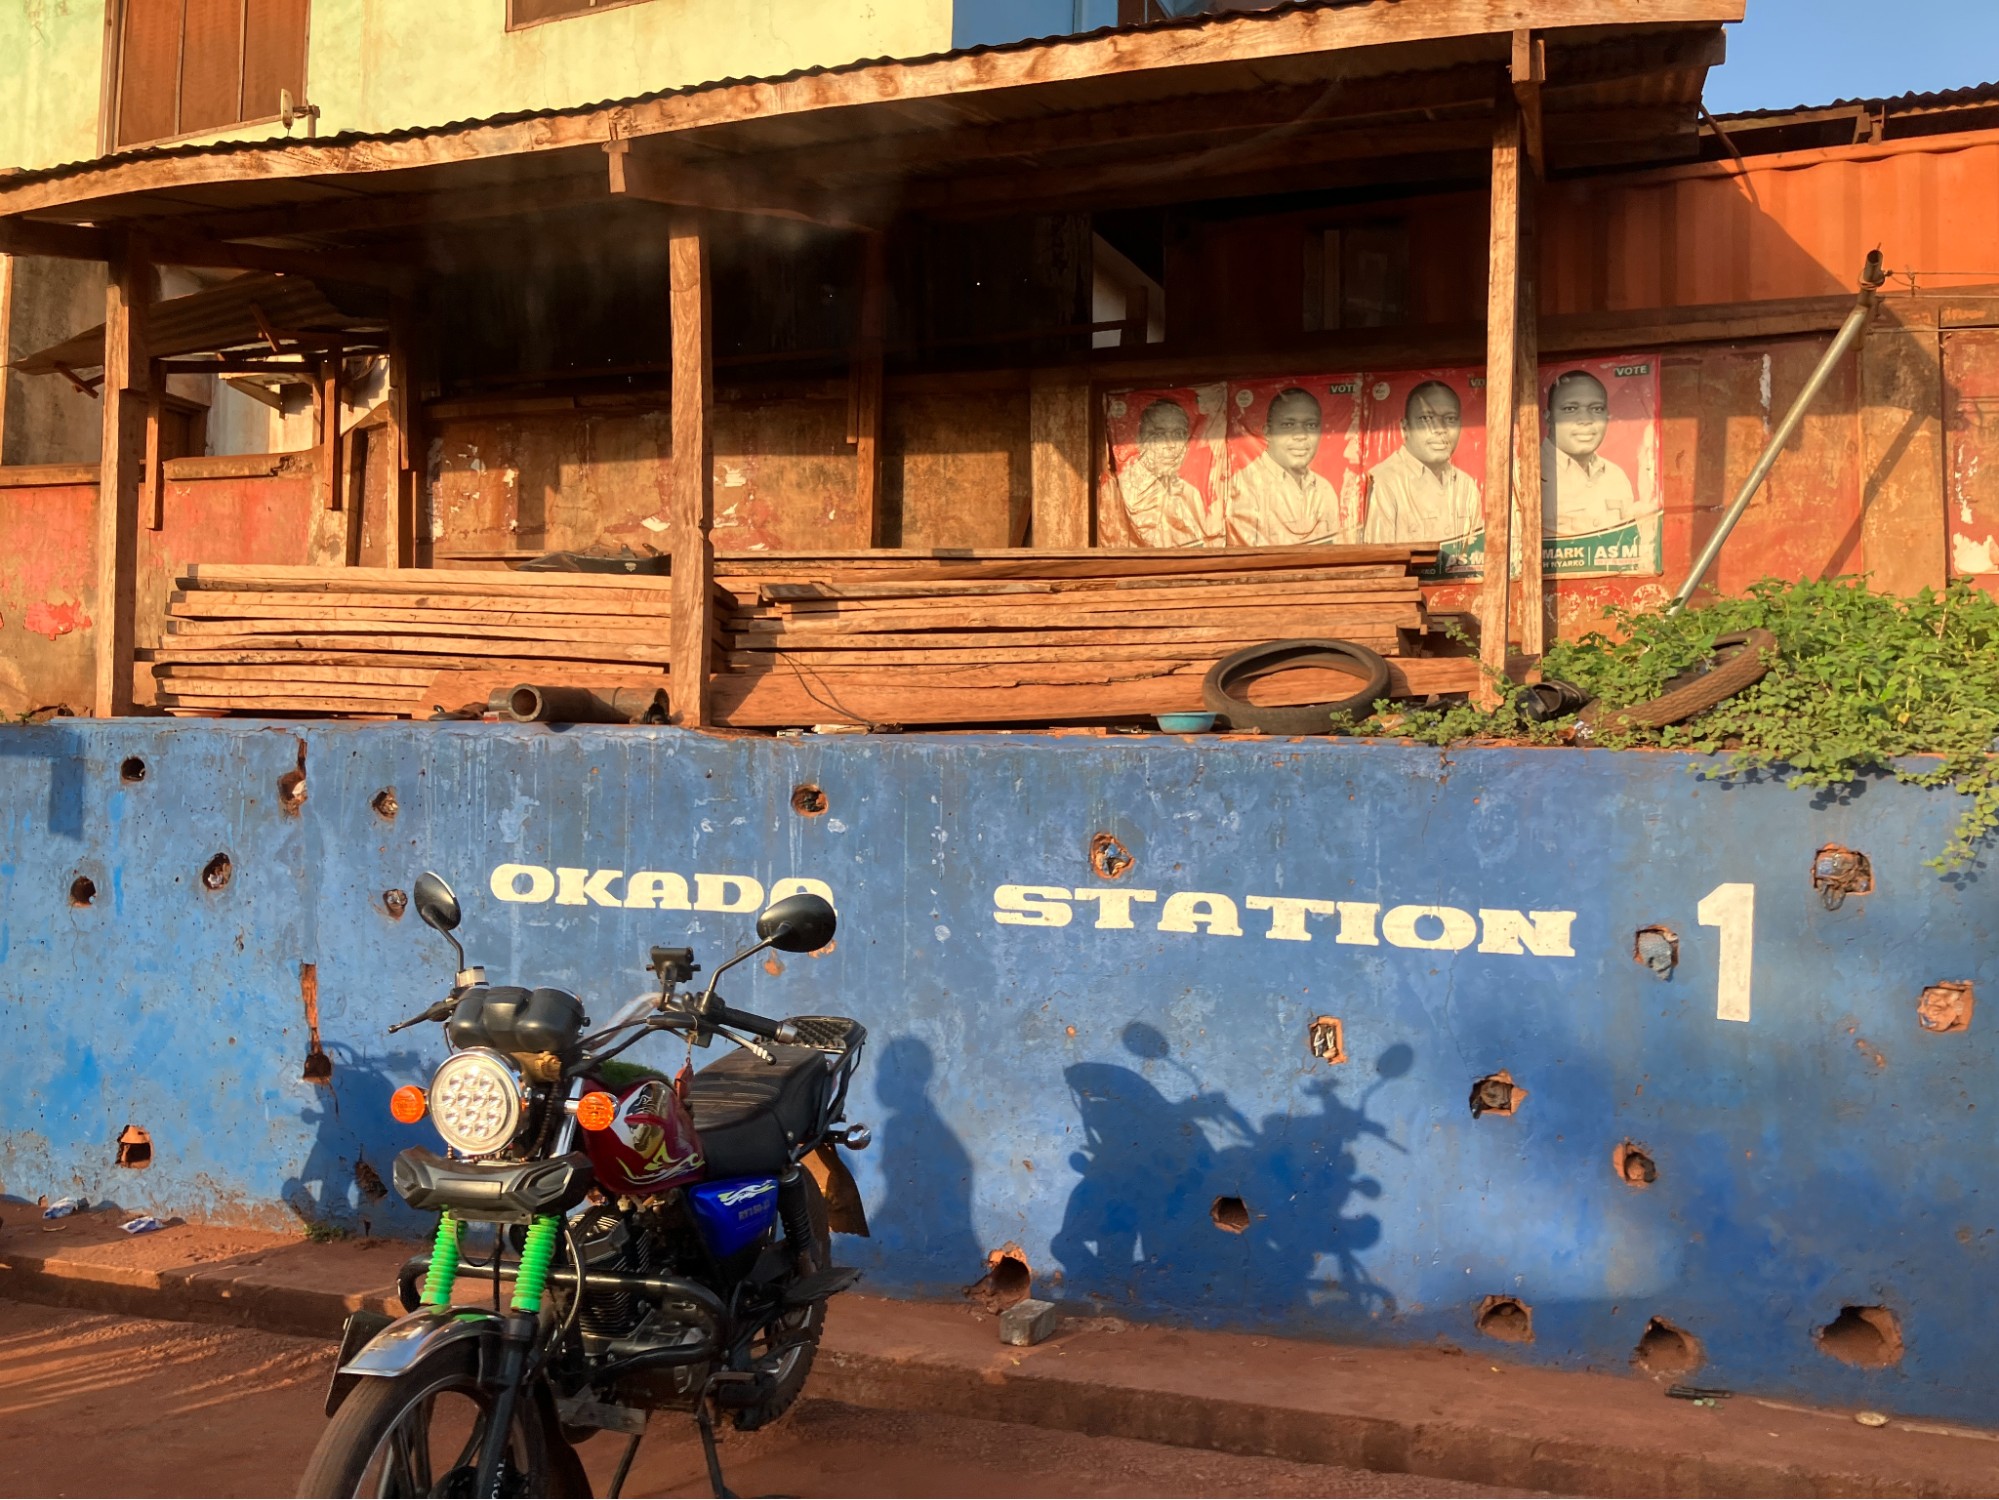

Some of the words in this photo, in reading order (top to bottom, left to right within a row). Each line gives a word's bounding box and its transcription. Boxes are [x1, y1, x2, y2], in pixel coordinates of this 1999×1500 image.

[1615, 364, 1648, 376] VOTE
[1542, 546, 1585, 560] MARK
[1594, 545, 1619, 559] AS
[1550, 559, 1585, 569] NYARKO
[993, 884, 1577, 957] STATION
[1697, 882, 1755, 1023] 1
